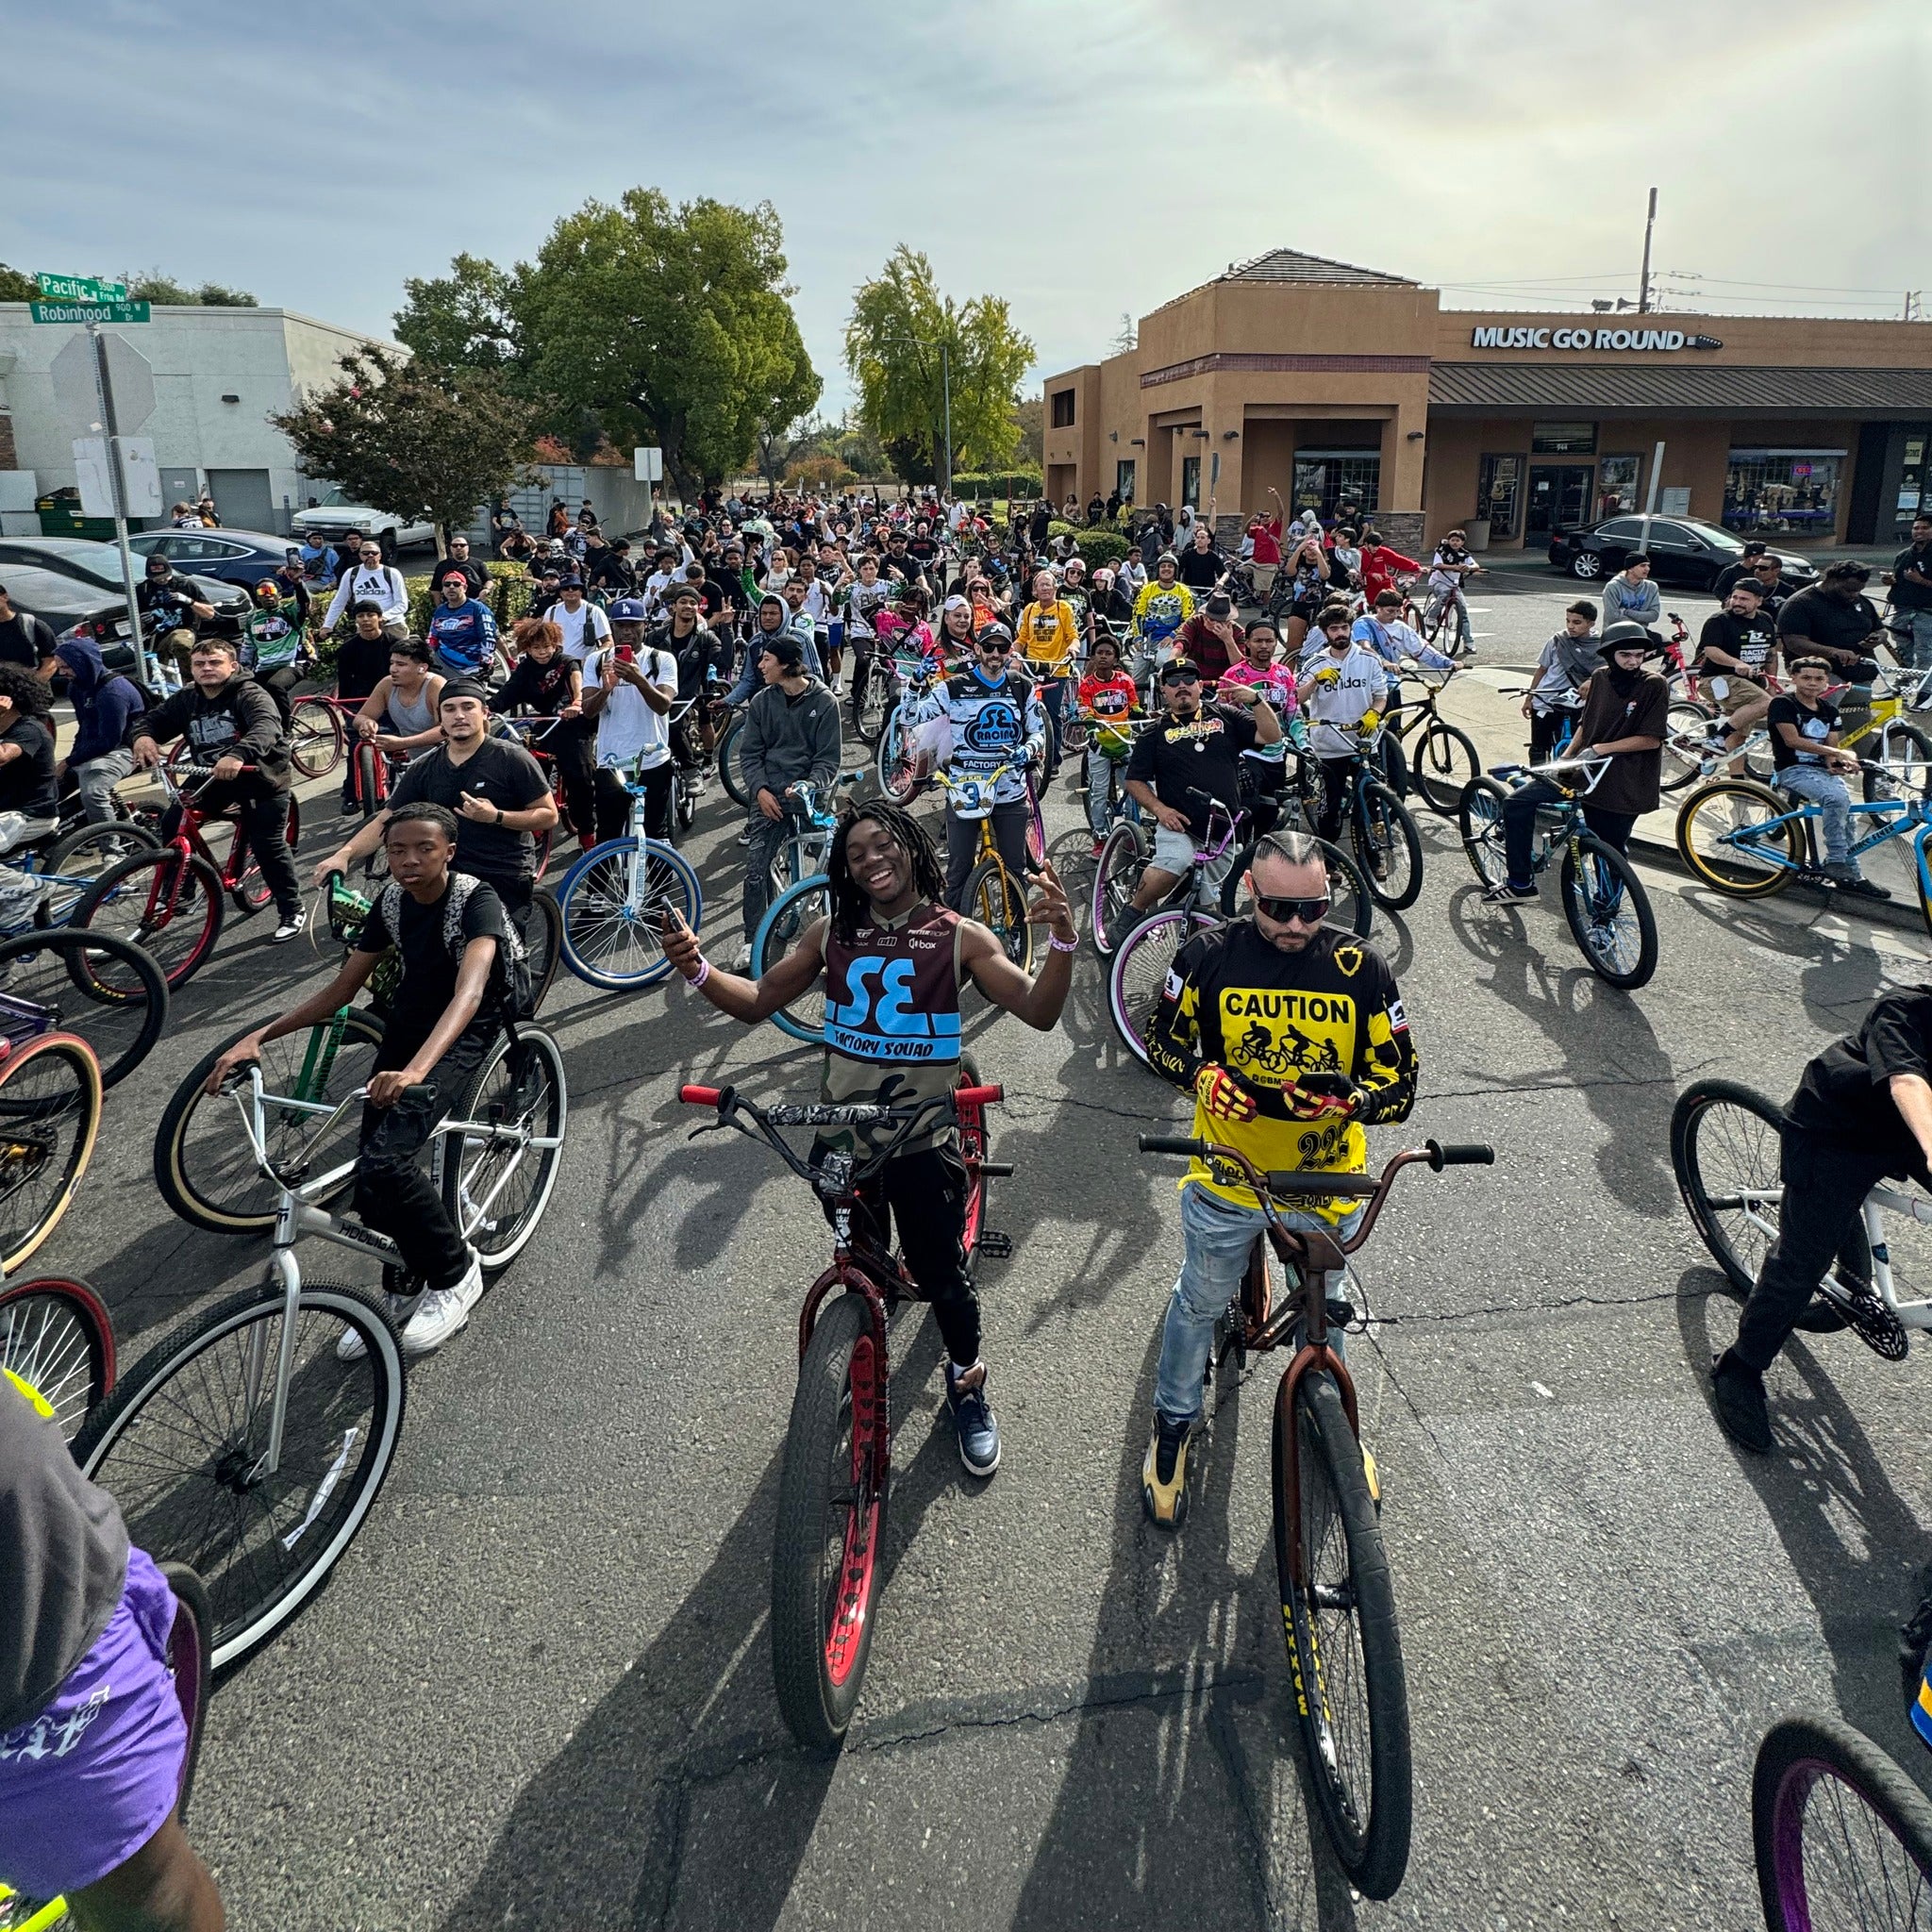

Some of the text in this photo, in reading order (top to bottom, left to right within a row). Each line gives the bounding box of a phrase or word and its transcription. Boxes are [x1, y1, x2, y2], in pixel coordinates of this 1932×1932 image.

[42, 275, 88, 298] Pacific
[39, 306, 111, 321] Robinhood
[115, 303, 131, 311] 900
[1473, 326, 1684, 350] MUSIC GO ROUND
[622, 603, 631, 614] LA
[1175, 658, 1186, 668] P
[982, 708, 1011, 728] SE
[963, 759, 1002, 770] FACTORY
[962, 782, 980, 810] 3
[919, 940, 937, 949] box
[837, 956, 930, 1035] SE
[1224, 992, 1349, 1024] CAUTION
[884, 1041, 934, 1057] SQUAD
[339, 1222, 399, 1255] HOOLIGA
[1283, 1605, 1309, 1716] MAXXIS
